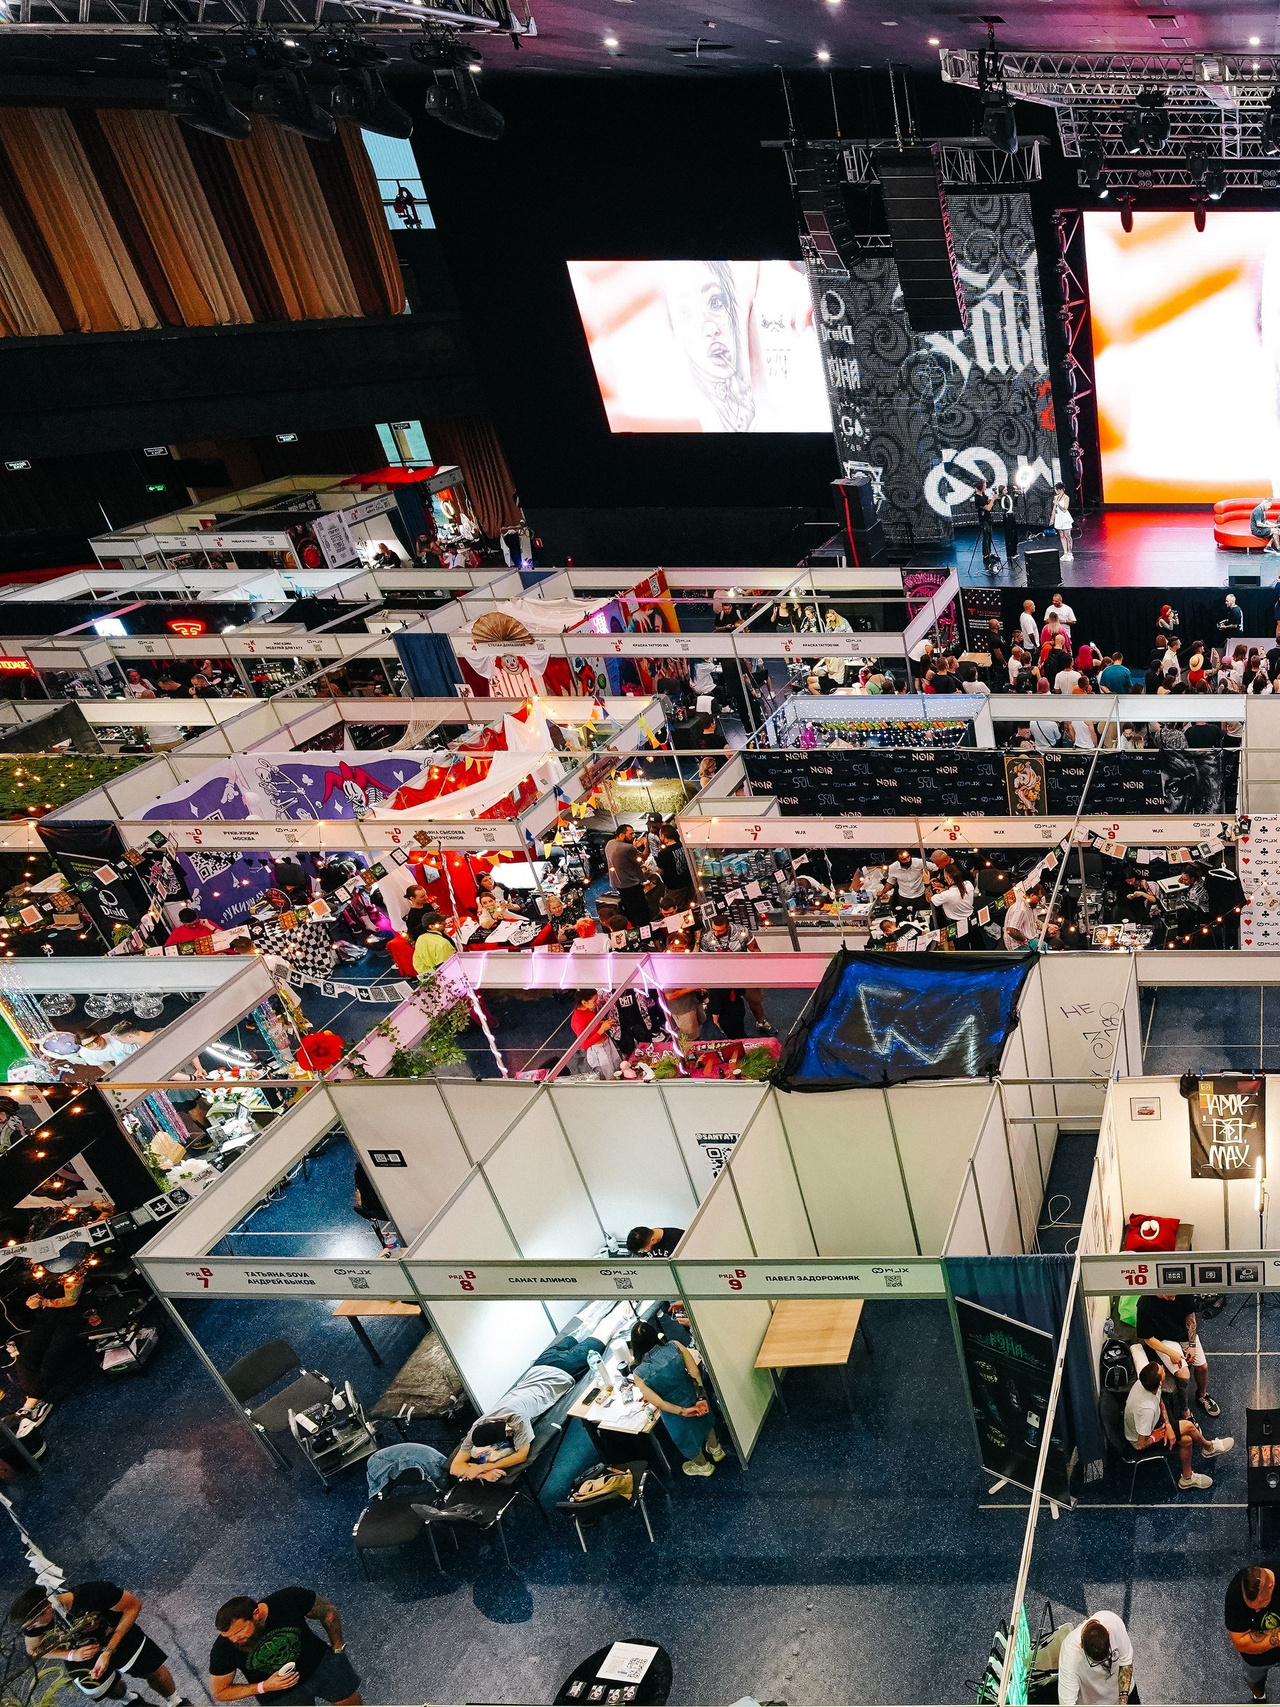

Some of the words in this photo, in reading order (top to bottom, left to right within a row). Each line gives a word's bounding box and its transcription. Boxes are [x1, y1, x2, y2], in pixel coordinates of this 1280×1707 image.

[785, 752, 809, 761] NOIR
[912, 752, 935, 761] NOIR
[810, 765, 833, 775] NOIR
[936, 765, 958, 774] NOIR
[1062, 768, 1085, 776] NOIR
[750, 780, 773, 789] NOIR
[876, 778, 898, 787] NOIR
[1122, 781, 1145, 790] NOIR
[776, 796, 799, 805] NOIR
[900, 795, 923, 804] NOIR
[194, 835, 202, 844] 5
[391, 835, 400, 844] 6
[750, 831, 759, 841] 7
[948, 831, 958, 841] 8
[1107, 831, 1116, 840] 9
[243, 1271, 285, 1279] ТАТЬЯНА
[196, 1277, 210, 1289] 7
[247, 1277, 284, 1286] АНДРЕЙ
[284, 1278, 316, 1286] БЫКОВ
[508, 1276, 538, 1284] САНАТ
[539, 1276, 578, 1284] АЛИМОВ
[730, 1278, 743, 1291] 9
[1124, 1274, 1147, 1286] 10
[461, 1279, 475, 1291] 8
